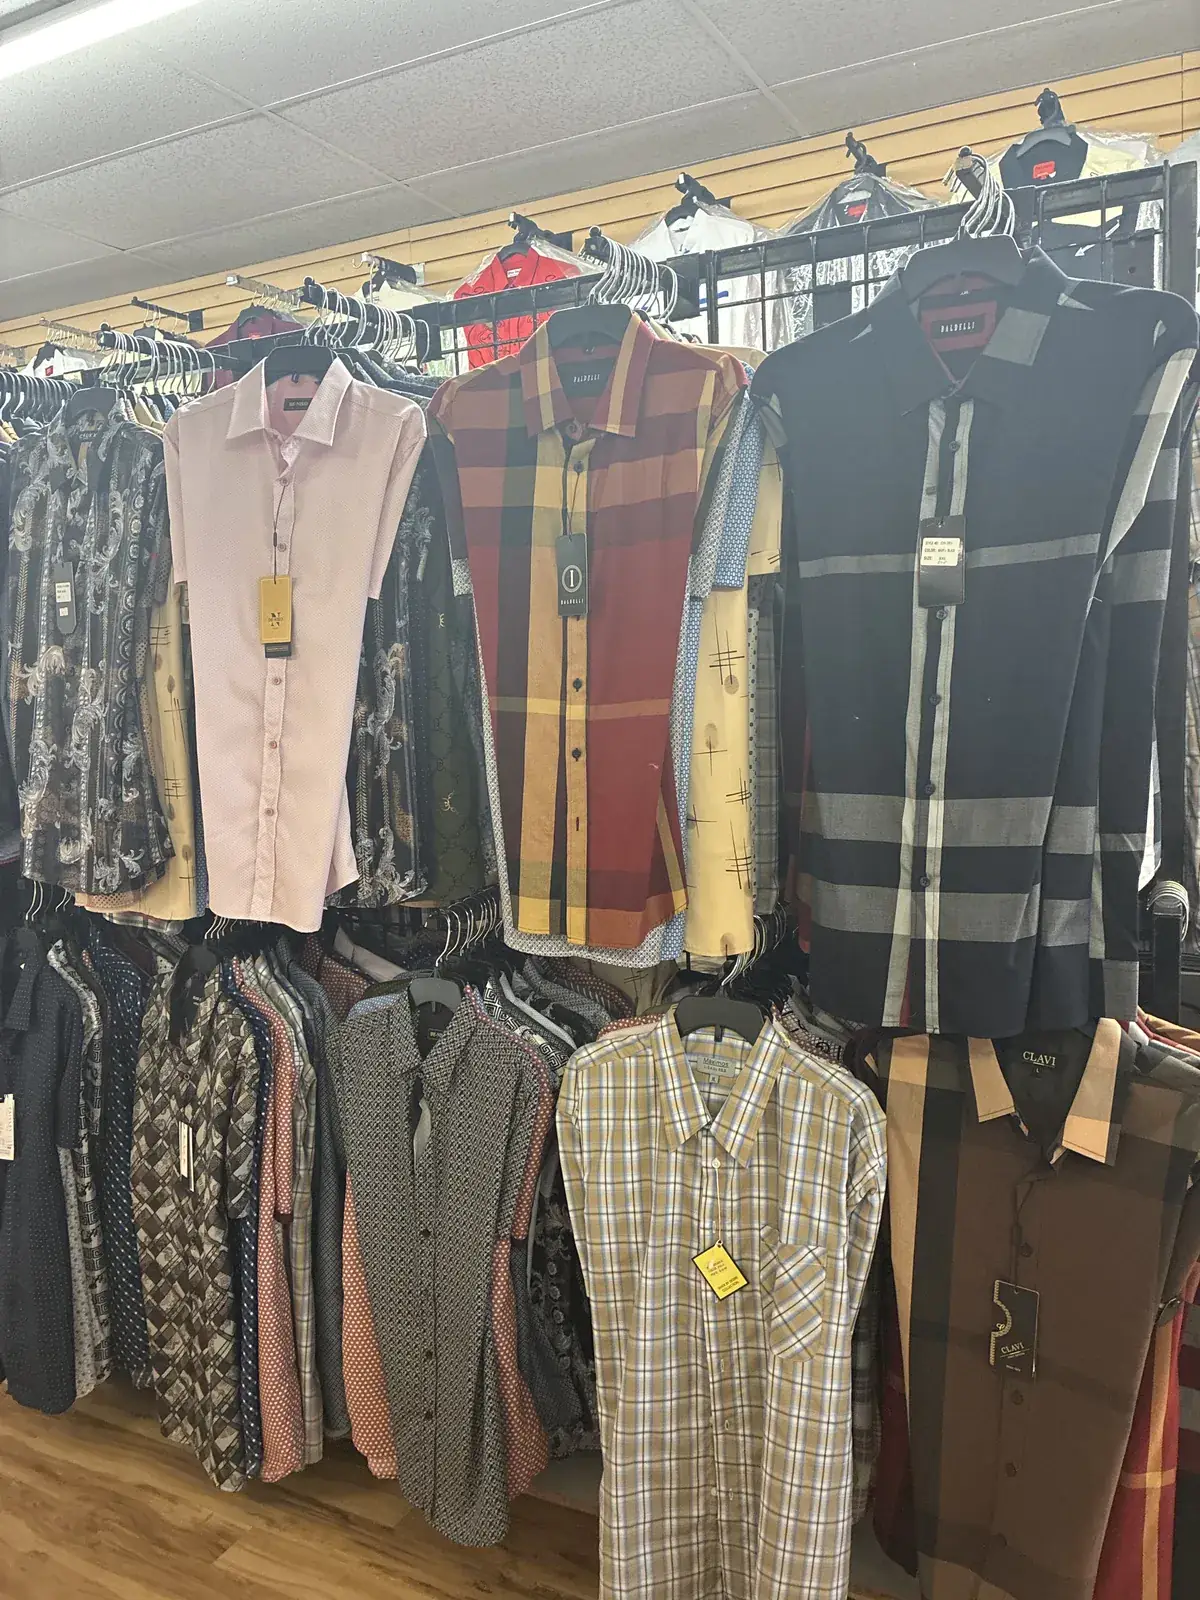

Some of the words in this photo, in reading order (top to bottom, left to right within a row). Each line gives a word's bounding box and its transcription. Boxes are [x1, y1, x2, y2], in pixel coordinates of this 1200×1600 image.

[940, 321, 975, 333] BALDELLI
[1022, 1050, 1057, 1066] CLAVI
[1000, 1341, 1025, 1354] CLAVI
